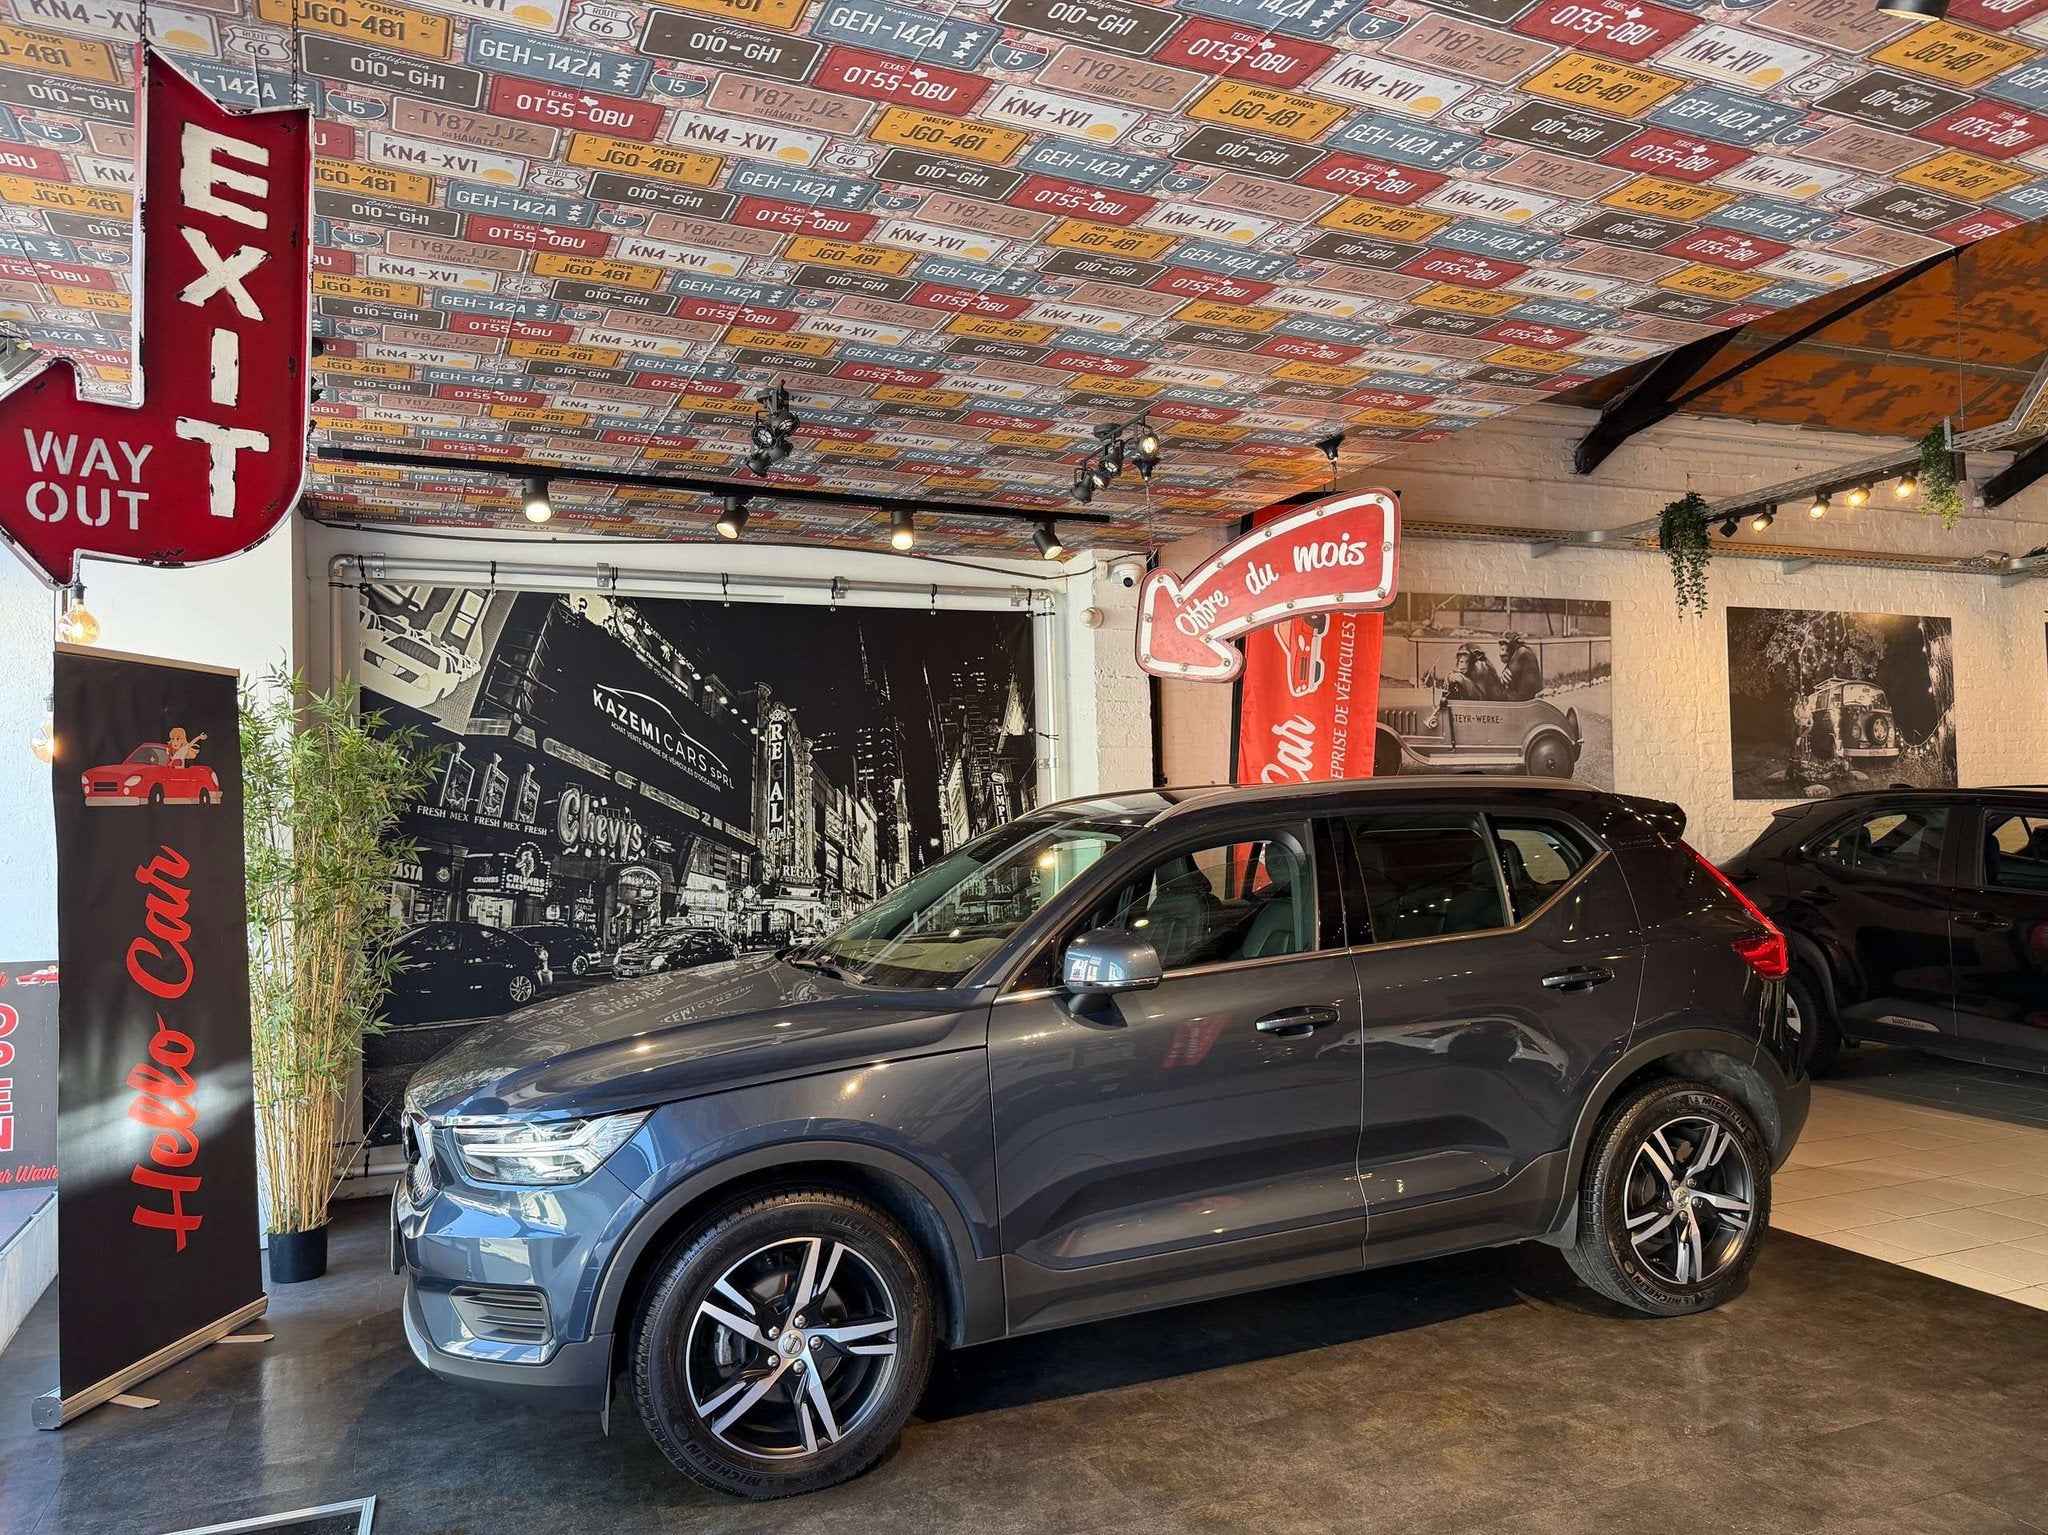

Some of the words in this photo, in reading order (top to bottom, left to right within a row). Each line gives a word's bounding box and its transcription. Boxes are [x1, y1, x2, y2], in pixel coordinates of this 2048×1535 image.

[587, 18, 615, 35] 66
[710, 26, 772, 46] California
[825, 6, 954, 50] GEH-142A
[1227, 30, 1259, 43] TEXAS
[1355, 17, 1388, 36] 15
[245, 42, 271, 57] 66
[1948, 29, 1983, 42] NEW
[1975, 37, 2015, 52] YORK
[477, 39, 606, 79] GEH-142A
[876, 60, 907, 72] TEXAS
[1000, 50, 1029, 67] 15
[1588, 61, 1623, 74] NEW
[1619, 70, 1659, 83] YORK
[544, 89, 575, 100] TEXAS
[1793, 78, 1827, 92] 66
[1246, 89, 1280, 101] NEW
[1280, 97, 1320, 110] YORK
[1662, 97, 1765, 131] GEH-142A
[44, 125, 62, 139] 15
[920, 115, 954, 126] NEW
[957, 122, 997, 135] YORK
[610, 140, 644, 151] NEW
[649, 147, 690, 158] YORK
[1139, 132, 1166, 145] 66
[1339, 123, 1443, 155] GEH-142A
[834, 155, 859, 167] 66
[934, 160, 984, 174] California
[1031, 147, 1135, 178] GEH-142A
[1360, 162, 1387, 171] TEXAS
[544, 177, 566, 188] 66
[736, 170, 841, 199] GEH-142A
[454, 190, 560, 216] GEH-142A
[1717, 205, 1804, 229] GEH-142A
[1175, 248, 1263, 270] GEH-142A
[676, 279, 765, 299] GEH-142A
[440, 295, 529, 314] GEH-142A
[175, 121, 271, 519] EXIT
[429, 371, 506, 385] GEH-142A
[971, 400, 1038, 413] GEH-142A
[23, 427, 153, 483] WAY
[26, 480, 149, 531] OUT
[1245, 561, 1279, 595] du
[1293, 532, 1368, 573] mois
[1336, 617, 1356, 699] VÉHICULES
[1335, 702, 1349, 722] DE
[592, 688, 661, 744] KAZEMI
[664, 733, 708, 772] CARS
[710, 766, 735, 790] SPRL
[1261, 714, 1317, 783] ar
[770, 723, 784, 823] REGAL
[417, 805, 446, 819] FRESH
[450, 811, 469, 822] MEX
[474, 815, 500, 828] FRESH
[503, 821, 520, 832] MEX
[524, 825, 547, 836] FRESH
[557, 787, 642, 861] Chevys
[473, 876, 499, 884] CRUMBS
[506, 874, 545, 888] CRUMBS
[125, 845, 193, 998] Car
[1701, 1098, 1748, 1132] MICHELIN
[127, 1012, 204, 1253] Hello
